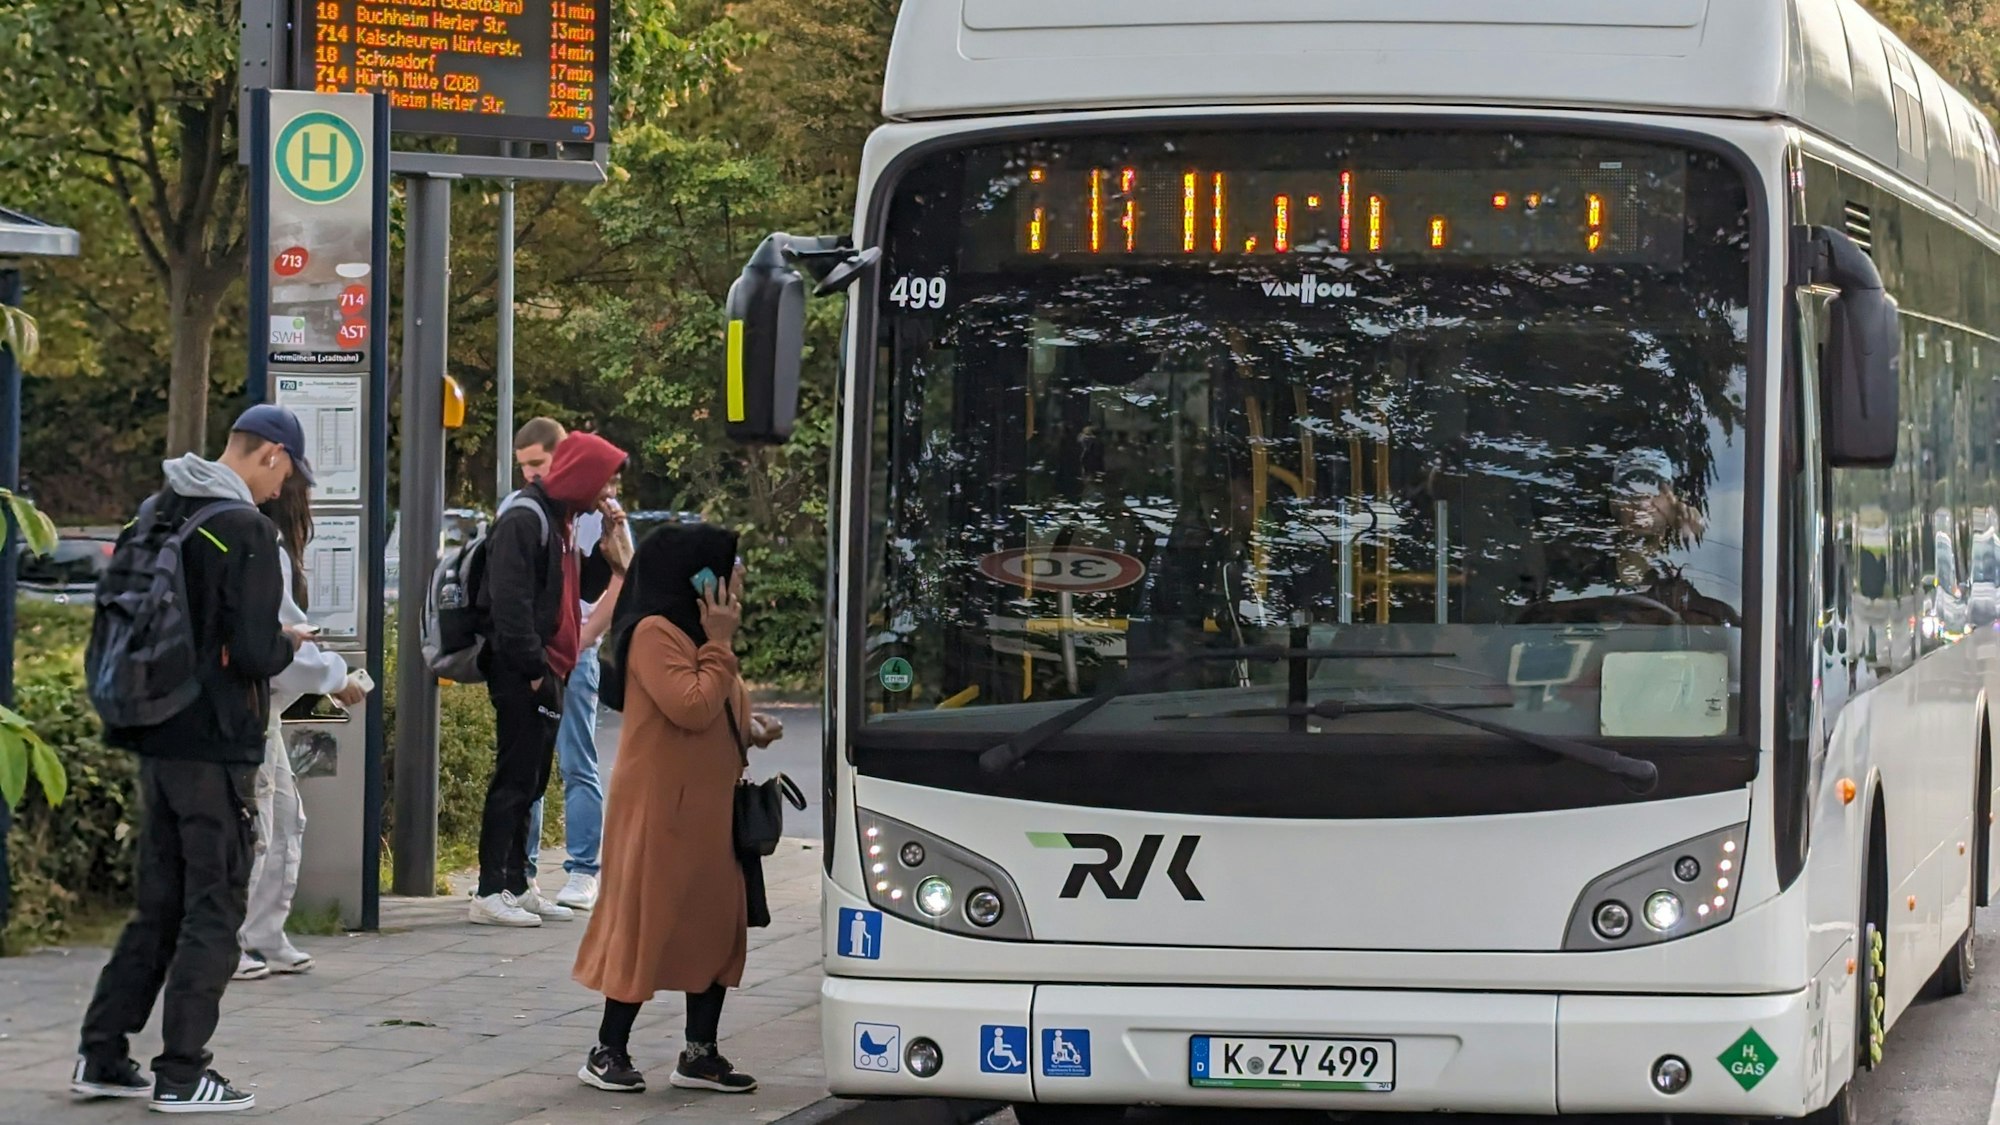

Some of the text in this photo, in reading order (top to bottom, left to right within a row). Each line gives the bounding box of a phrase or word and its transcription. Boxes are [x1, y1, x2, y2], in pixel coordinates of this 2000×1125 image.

[316, 2, 595, 41] 18 Buchheim Herler Str. 13min
[551, 2, 595, 20] 11min
[316, 23, 348, 42] 714
[356, 27, 448, 50] Kalscheuren
[550, 43, 595, 61] 14min
[316, 46, 594, 82] 18 Schwadorf 17min
[316, 65, 594, 101] 714 Hürth Mitte (ZOB) 18min
[431, 92, 477, 111] Herler
[481, 95, 506, 114] Str.
[548, 102, 594, 120] 23min
[302, 132, 338, 182] H
[281, 254, 303, 268] 713
[340, 294, 364, 306] 714
[889, 276, 947, 309] 499
[272, 331, 303, 343] SWH
[340, 325, 366, 339] AST
[892, 660, 901, 675] 4
[1056, 833, 1206, 901] RVK
[1223, 1043, 1244, 1075] K
[1268, 1044, 1310, 1076] ZY
[1318, 1045, 1379, 1077] 499
[1731, 1061, 1765, 1076] GAS
